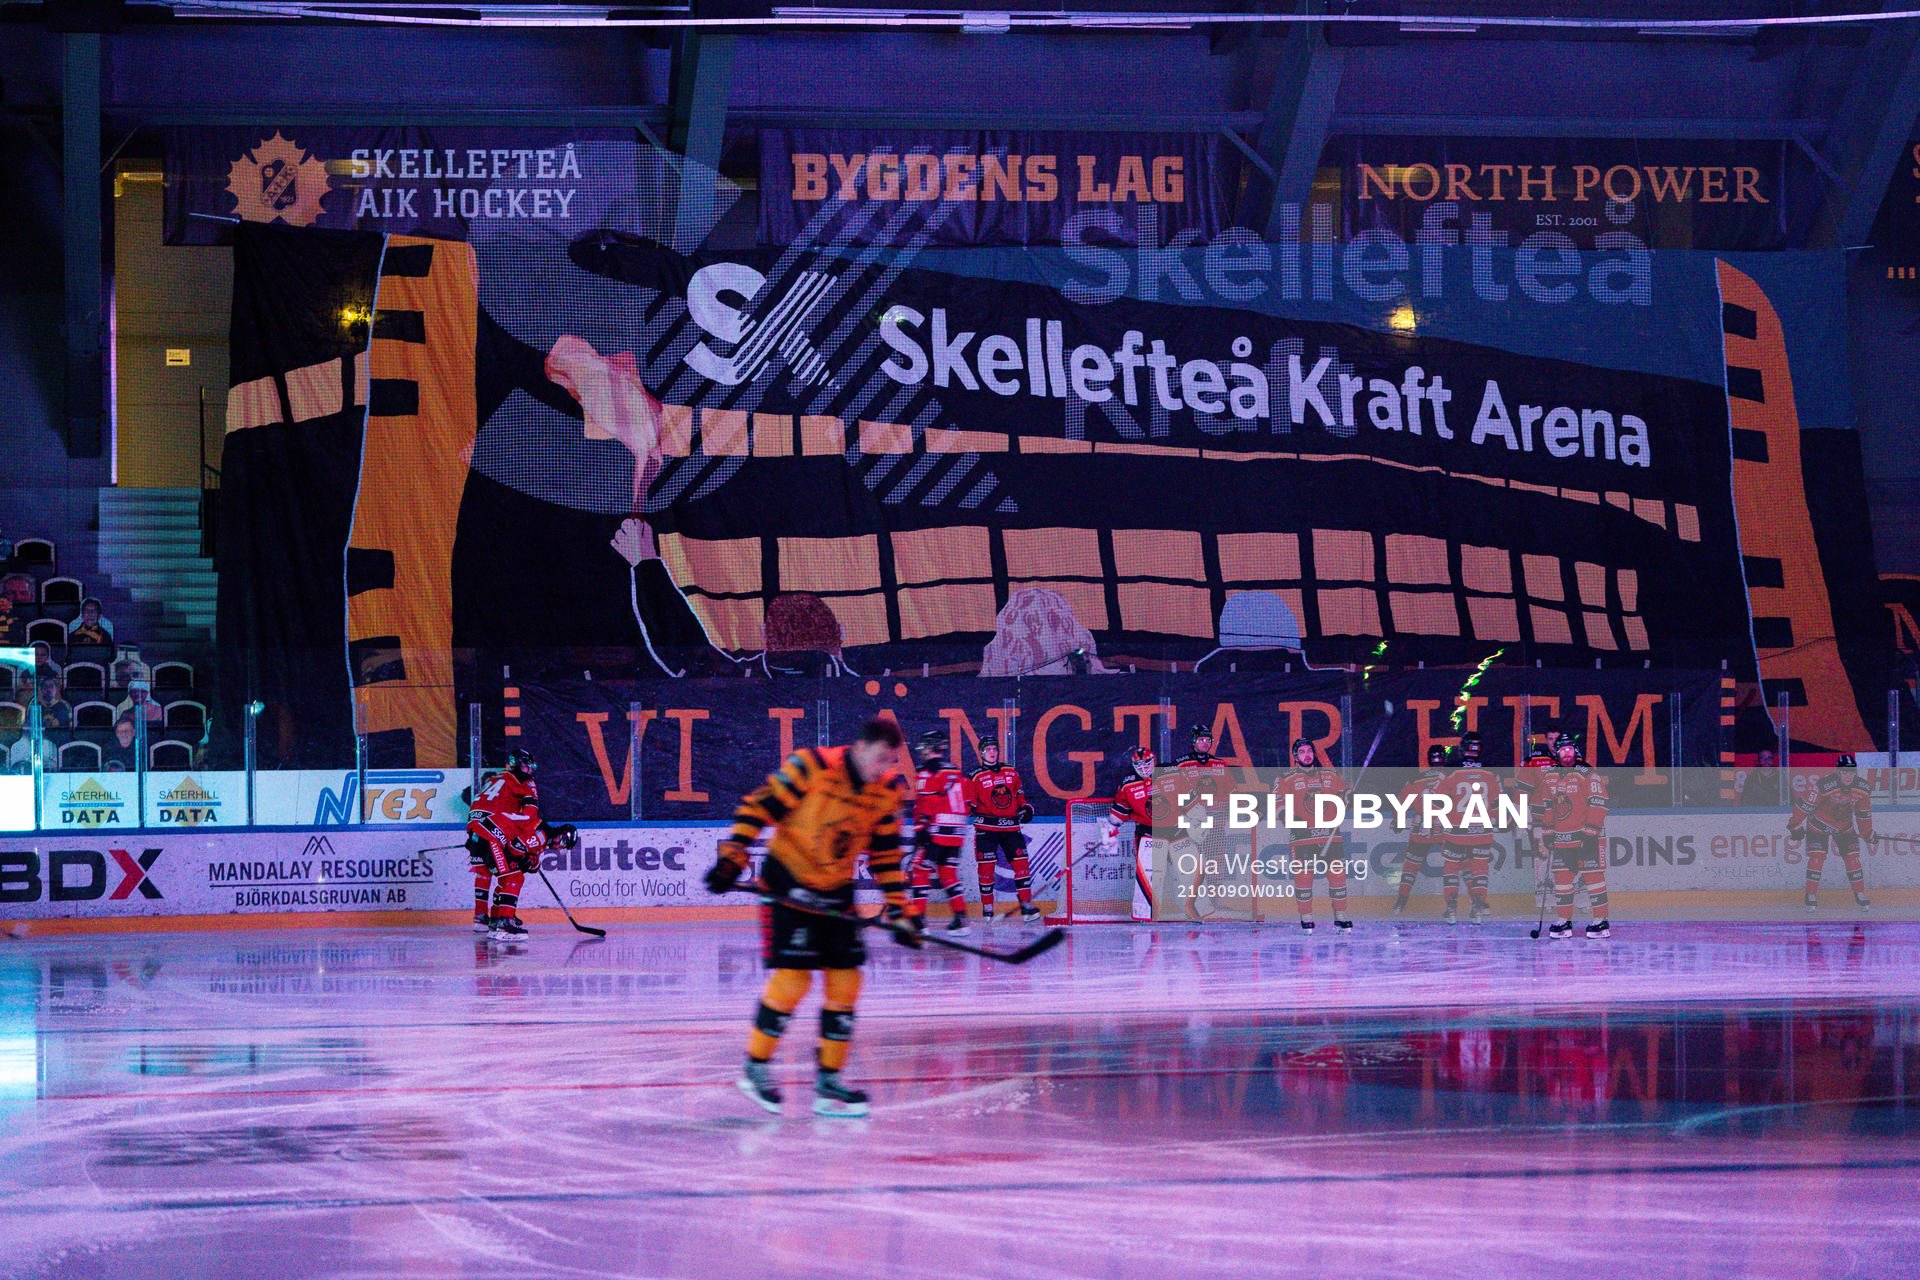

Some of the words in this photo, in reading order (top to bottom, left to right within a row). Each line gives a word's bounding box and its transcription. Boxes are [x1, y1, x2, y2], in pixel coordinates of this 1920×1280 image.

[351, 142, 582, 179] SKELLEFTEÅ
[791, 153, 1058, 202] BYGDENS
[1076, 156, 1185, 203] LAG
[1357, 162, 1550, 201] NORTH
[1573, 163, 1769, 203] POWER
[356, 189, 416, 218] AIK
[433, 188, 576, 218] HOCKEY
[1535, 214, 1566, 226] EST.
[1569, 215, 1598, 226] 2001
[880, 304, 1269, 419] Skellefteå
[1288, 354, 1454, 440] Kraft
[1470, 380, 1651, 468] Arena
[576, 708, 710, 805] VI
[62, 809, 121, 824] DATA
[159, 808, 218, 823] DATA
[1311, 828, 1330, 838] SSAB
[539, 837, 686, 872] alutec
[0, 848, 164, 903] BDX
[208, 861, 313, 881] MANDALAY
[320, 859, 434, 879] RESOURCES
[235, 886, 382, 907] BJÖRKDALSGRUVAN
[388, 888, 407, 905] AB
[570, 878, 608, 898] Good
[610, 878, 634, 897] for
[637, 878, 686, 897] Wood
